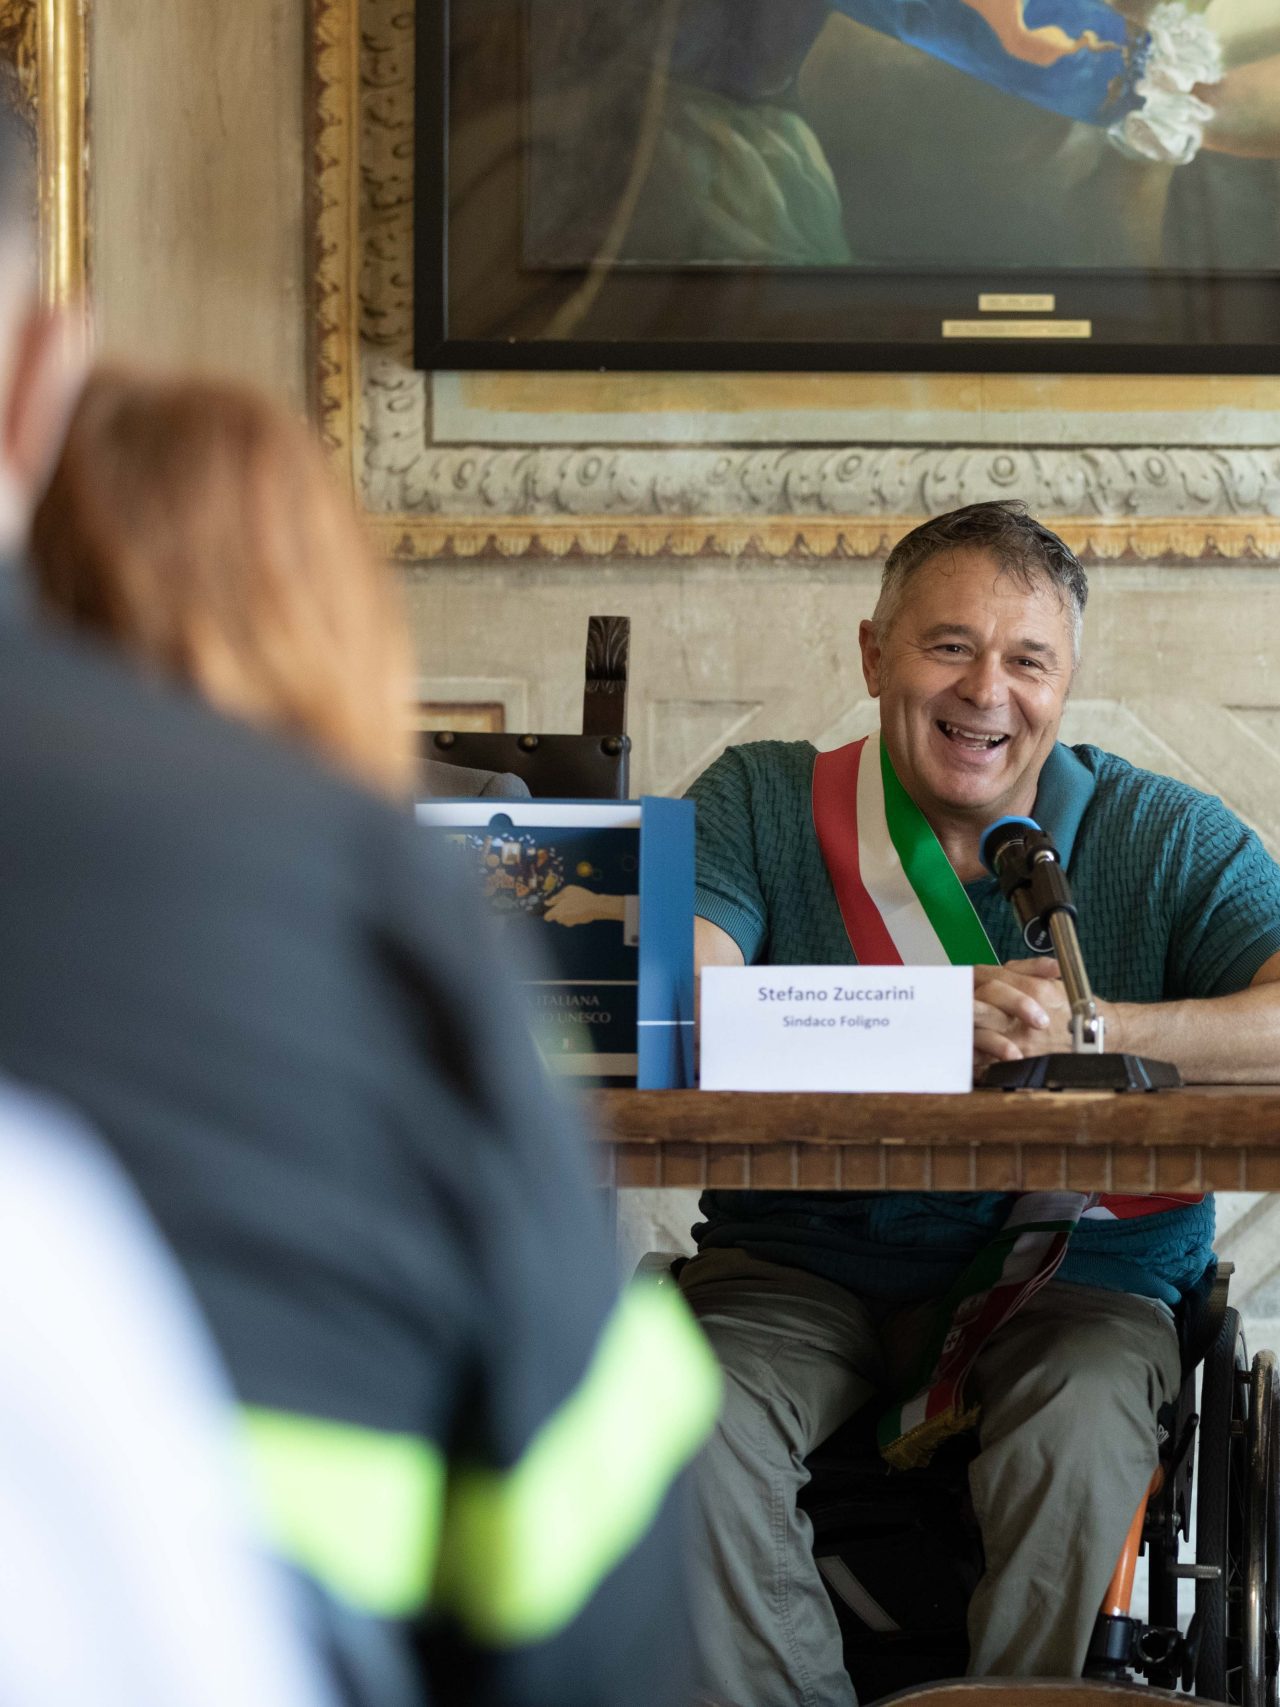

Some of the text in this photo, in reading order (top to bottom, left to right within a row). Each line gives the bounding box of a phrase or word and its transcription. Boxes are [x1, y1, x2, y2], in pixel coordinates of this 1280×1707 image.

[757, 986, 915, 1002] Stefano Zuccarini
[558, 1012, 612, 1024] UNESCO
[782, 1016, 890, 1029] Sindaco Foligno
